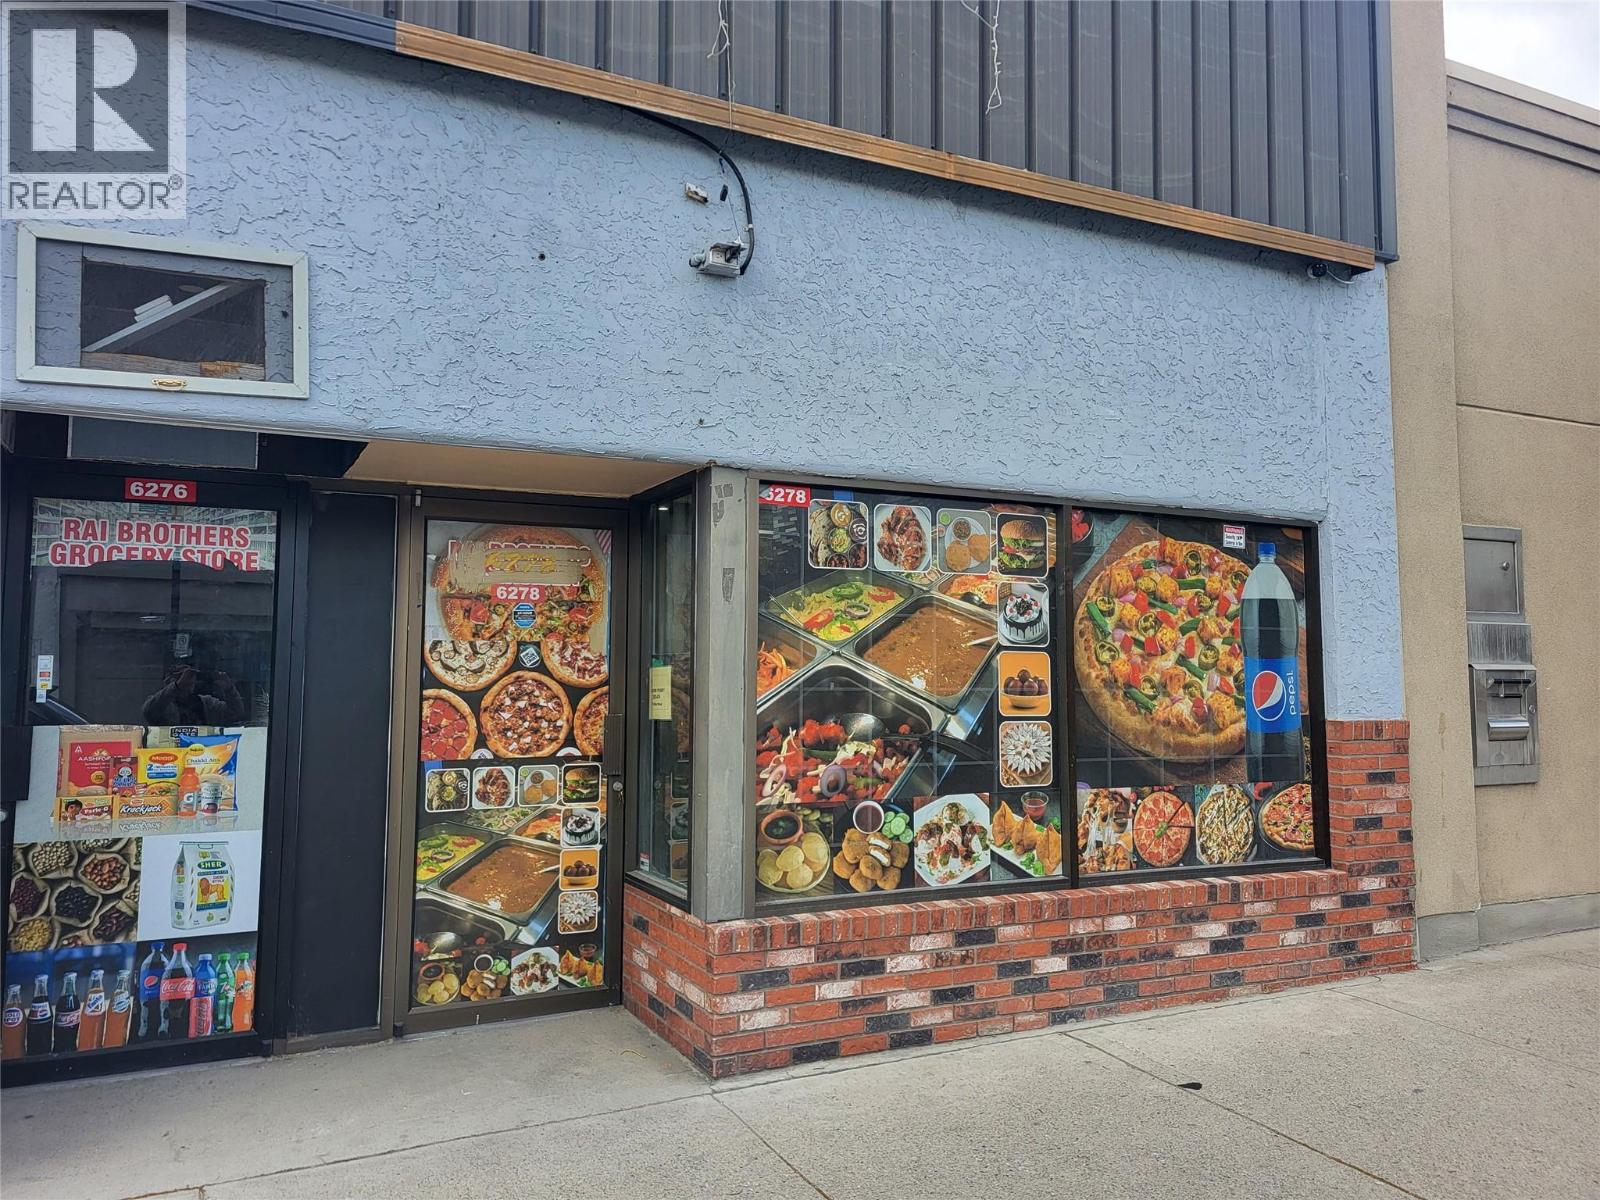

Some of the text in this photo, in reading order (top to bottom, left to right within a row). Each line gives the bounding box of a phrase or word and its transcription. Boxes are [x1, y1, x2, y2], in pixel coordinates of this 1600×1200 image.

[130, 481, 188, 499] 6276
[63, 518, 250, 548] RAI BROTHERS
[496, 586, 540, 600] 6278
[1289, 672, 1297, 716] pepsi
